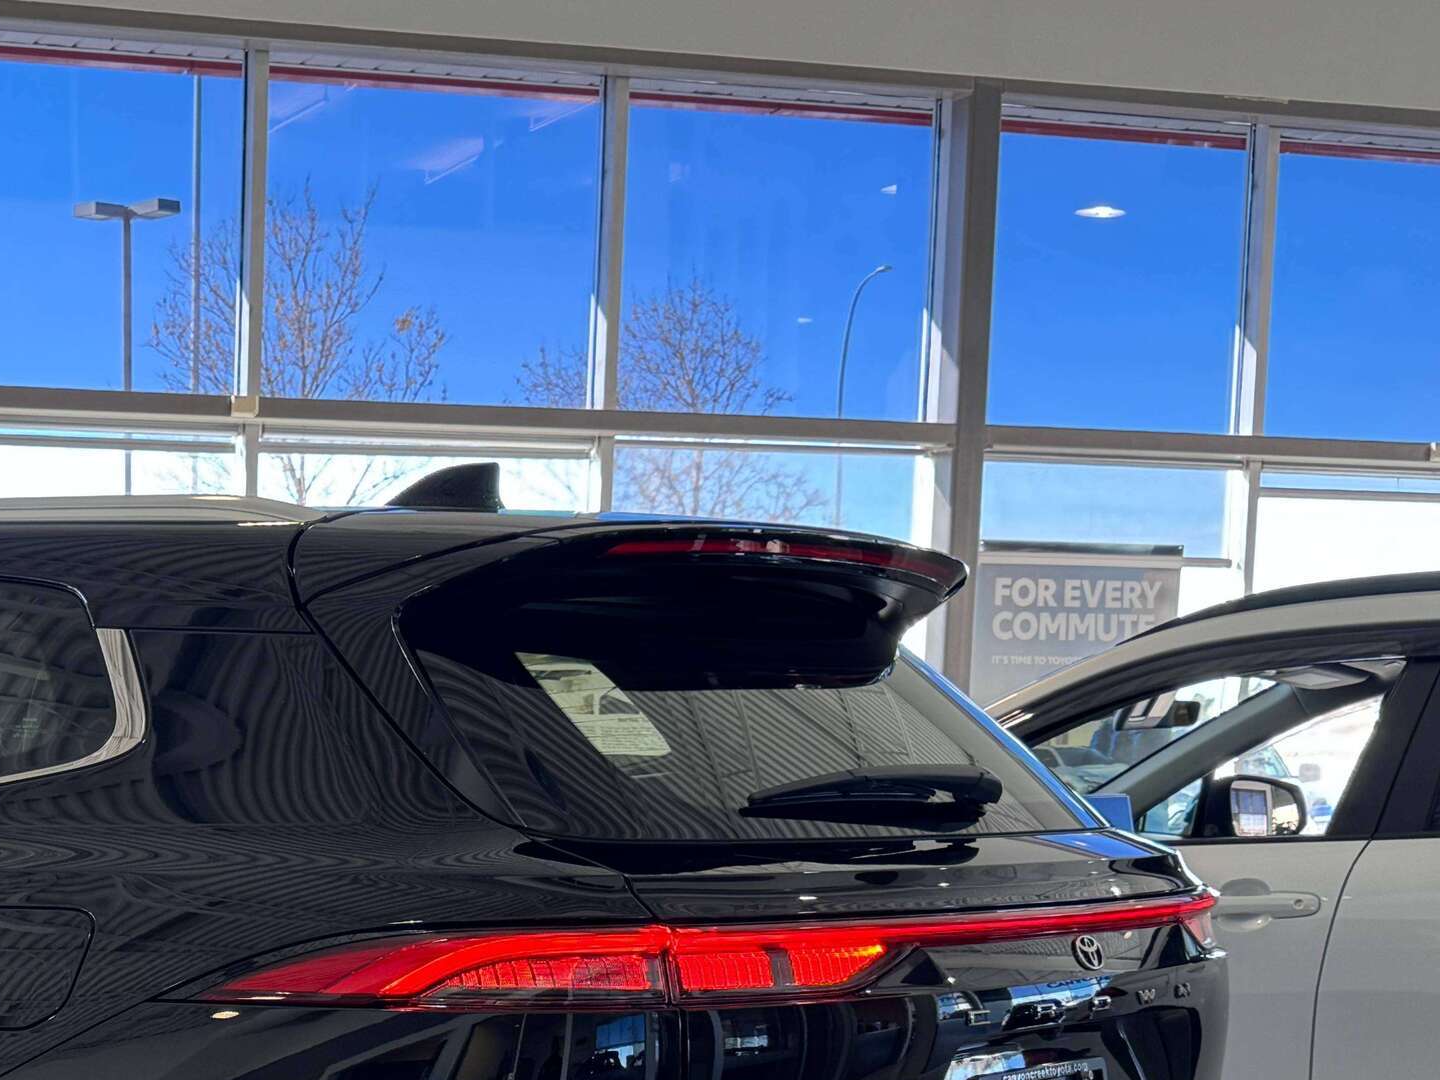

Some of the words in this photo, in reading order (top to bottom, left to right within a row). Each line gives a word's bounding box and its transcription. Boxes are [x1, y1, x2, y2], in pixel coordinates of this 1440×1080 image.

[994, 577, 1058, 607] FOR
[1063, 579, 1163, 609] EVERY
[1010, 655, 1033, 665] TIME
[1034, 656, 1047, 665] TO
